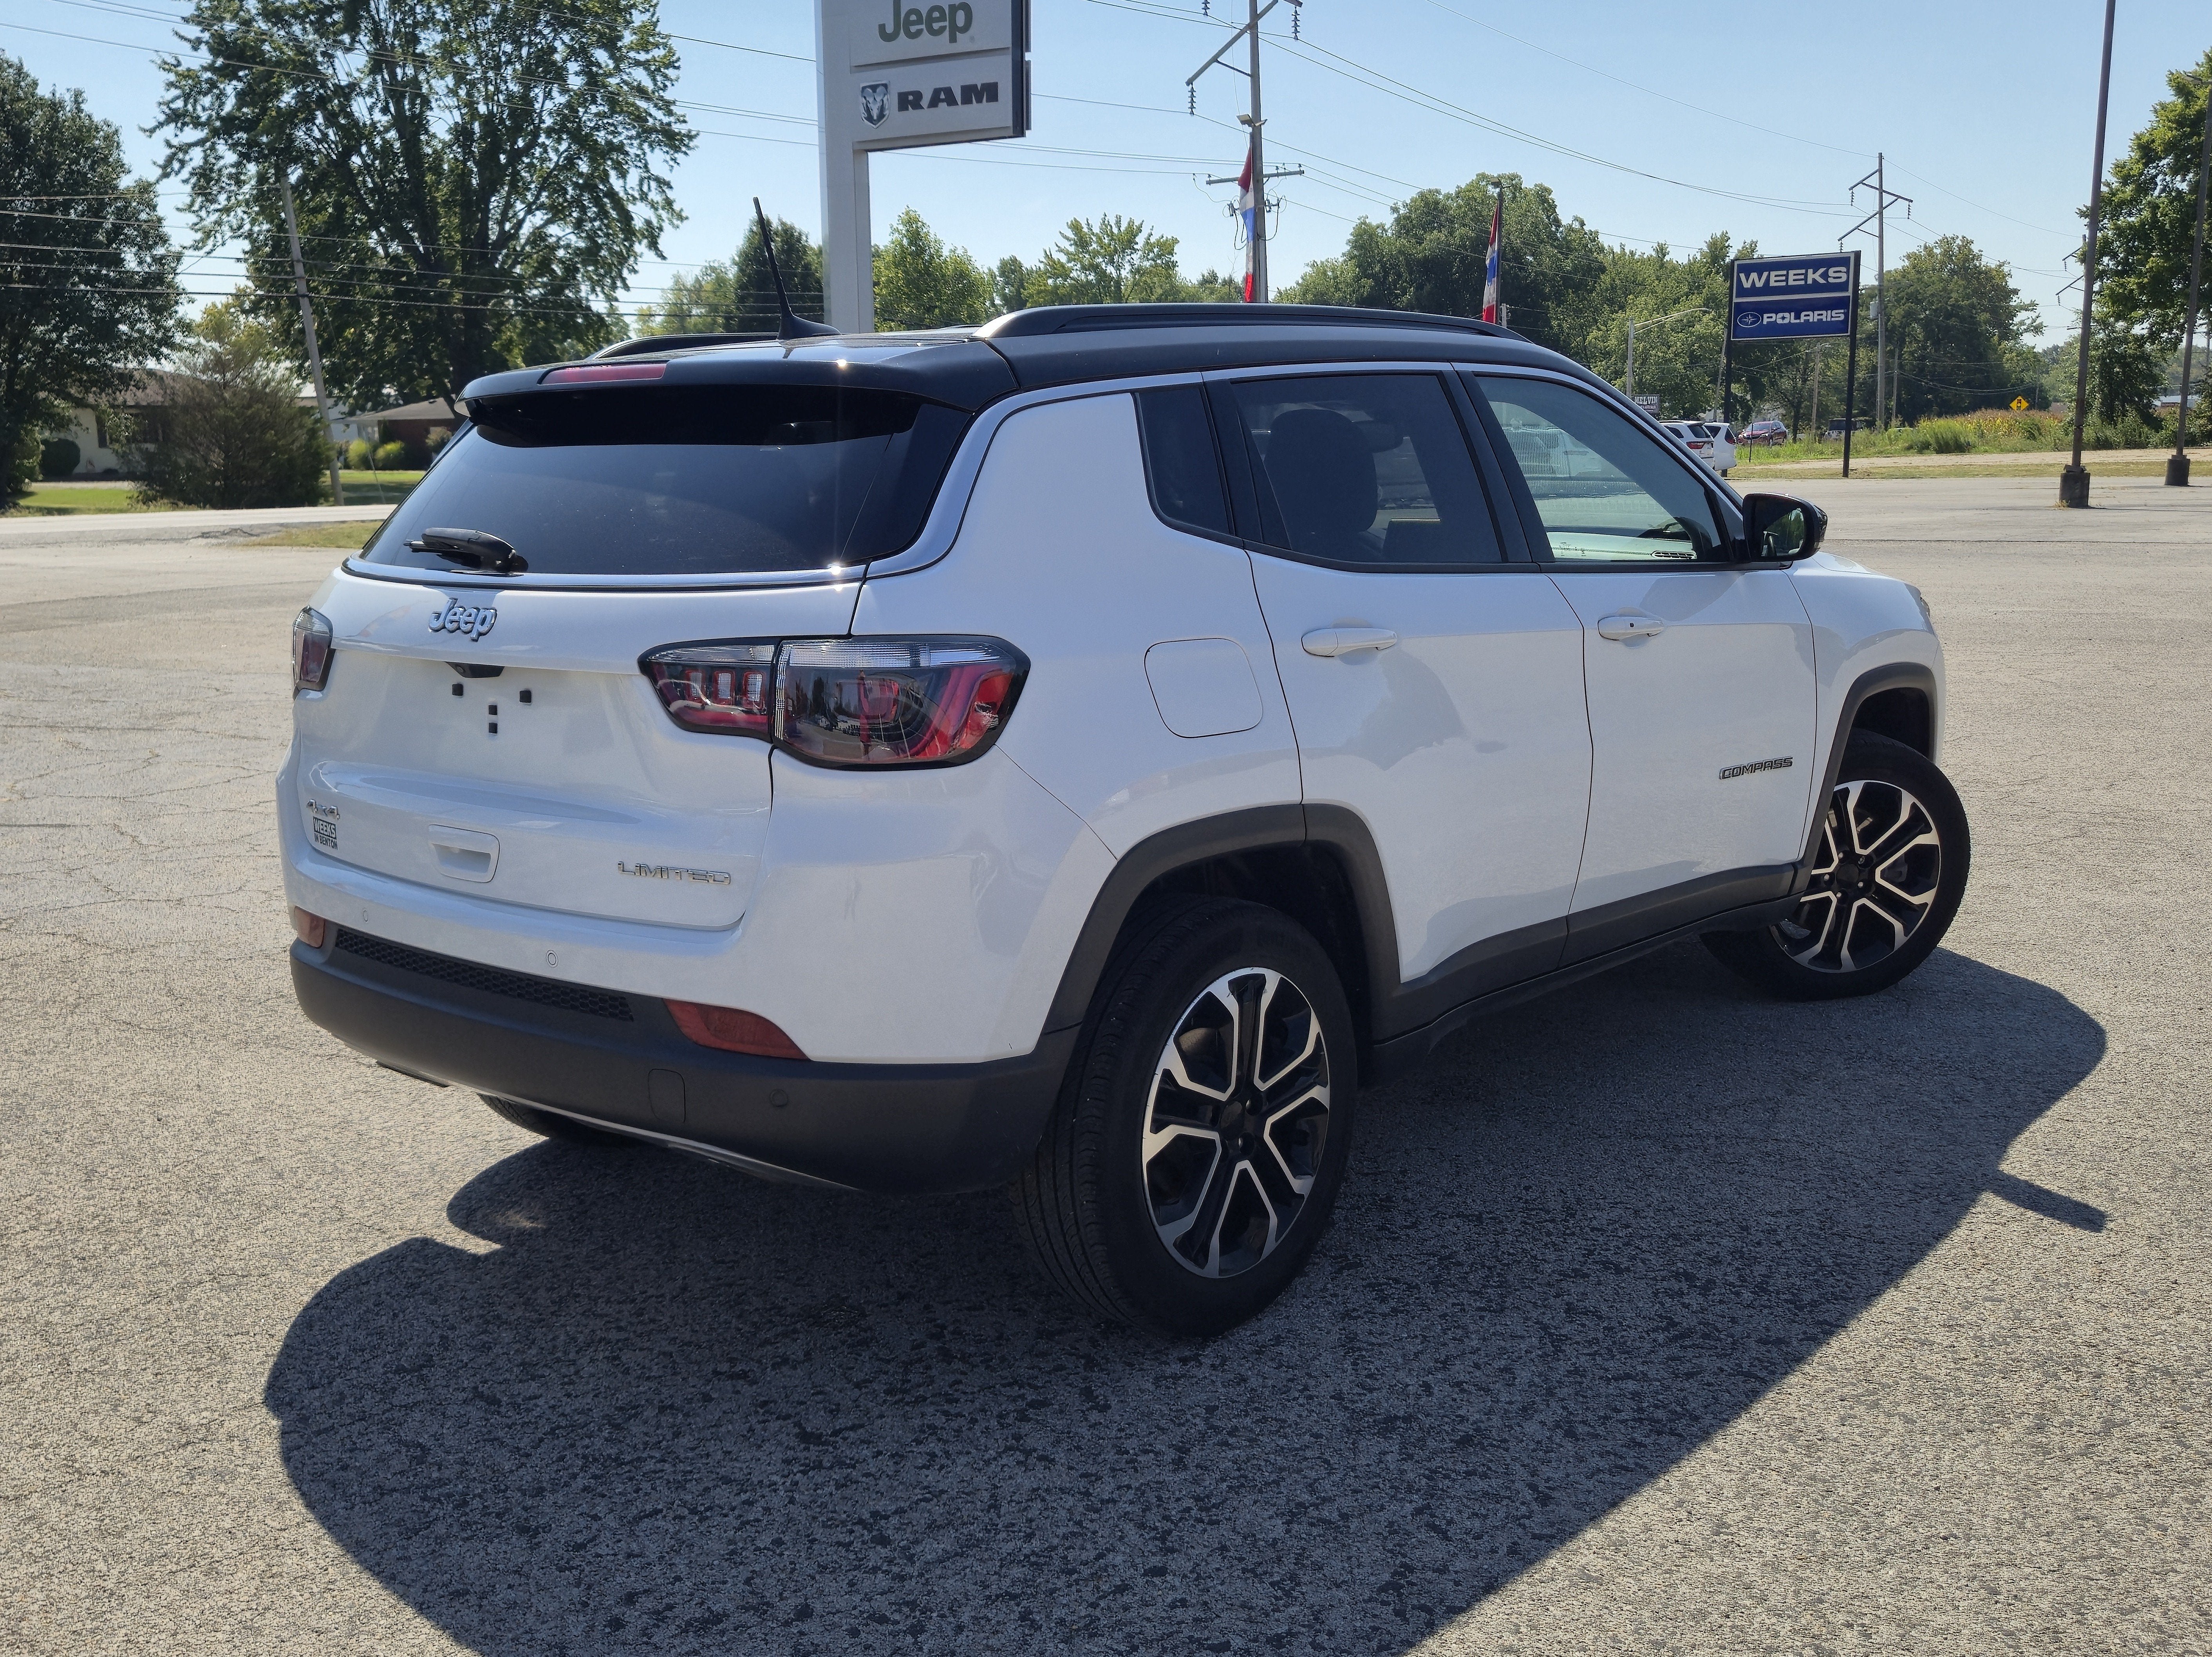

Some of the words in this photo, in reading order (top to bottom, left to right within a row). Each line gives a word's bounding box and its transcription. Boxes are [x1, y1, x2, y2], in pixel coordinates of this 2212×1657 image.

[878, 0, 973, 43] Jeep
[897, 81, 999, 112] RAM
[1739, 267, 1847, 288] WEEKS
[1763, 309, 1845, 325] POLARIS
[1635, 396, 1657, 405] MELVIN
[429, 597, 497, 642] Jeep
[1719, 756, 1793, 780] COMPASS
[314, 818, 336, 838] WEEKS
[617, 861, 731, 884] LIMITED
